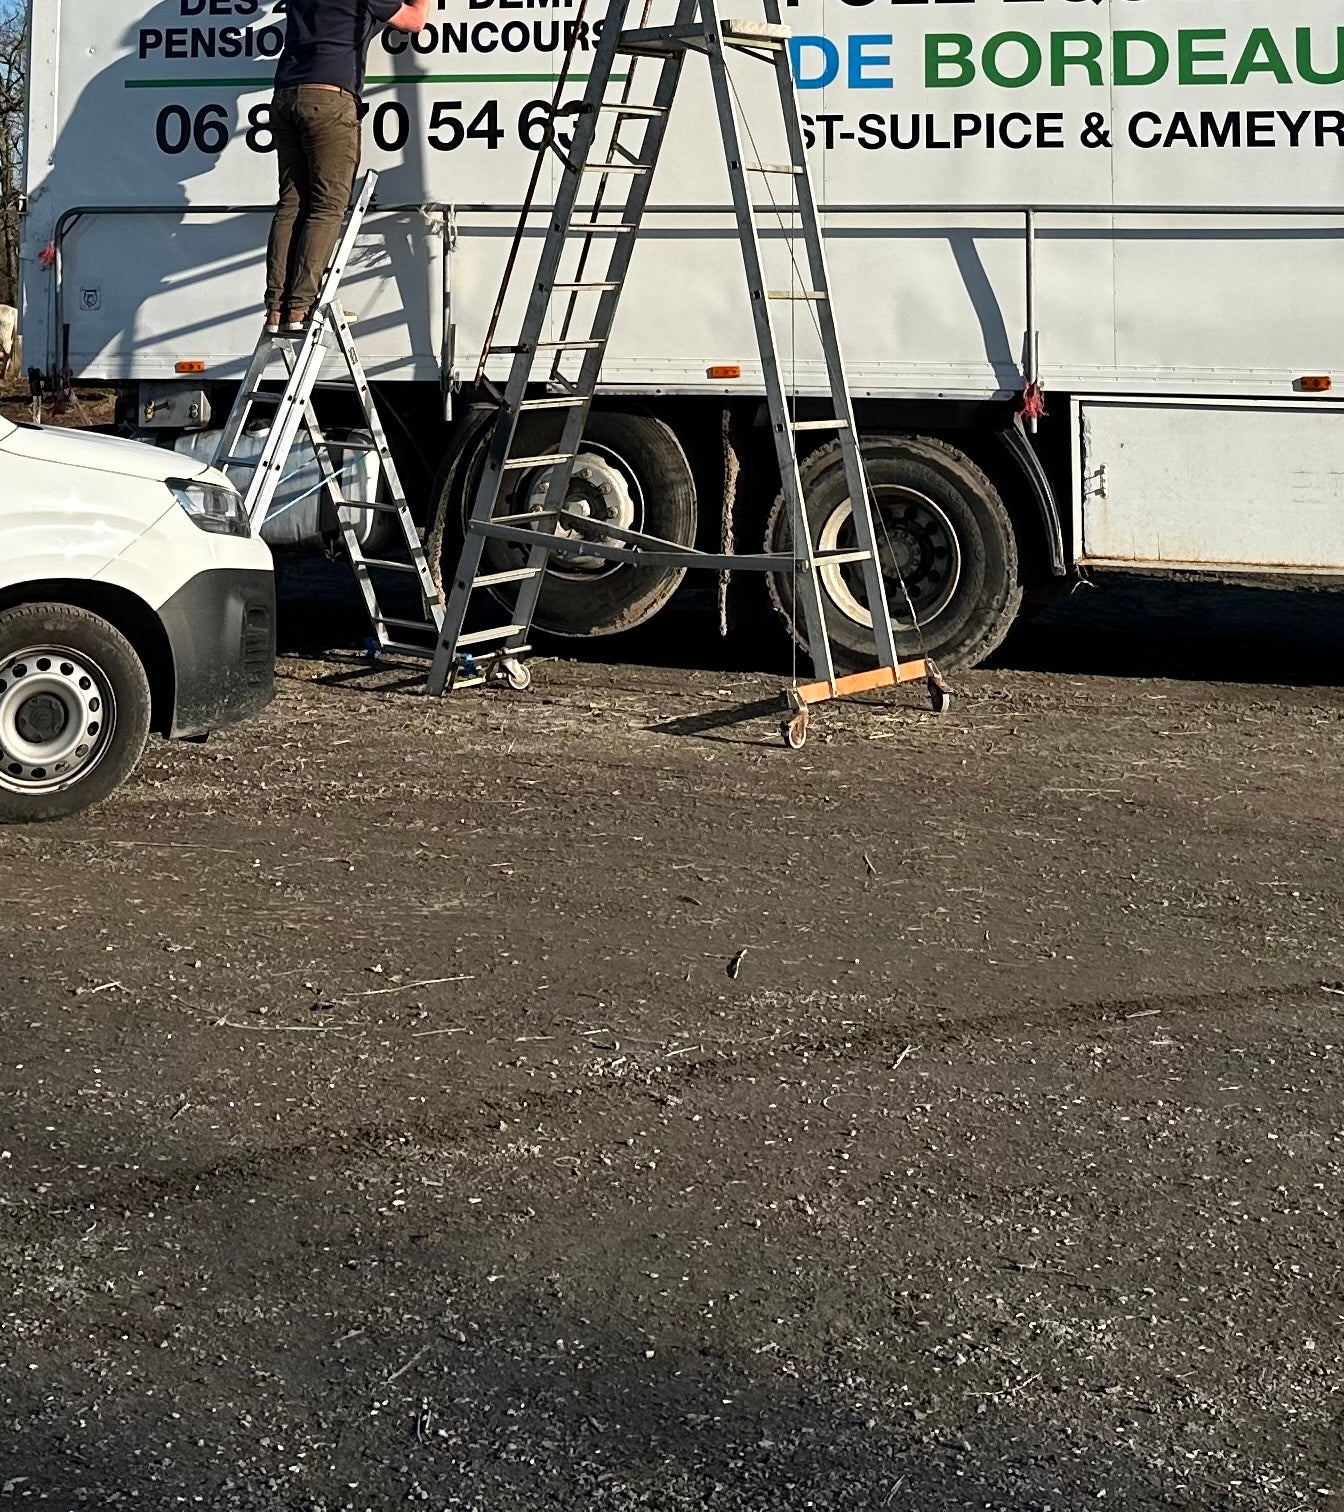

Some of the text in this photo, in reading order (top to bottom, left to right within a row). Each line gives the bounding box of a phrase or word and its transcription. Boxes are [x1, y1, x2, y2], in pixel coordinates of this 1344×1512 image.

[788, 34, 894, 89] DE
[156, 103, 229, 155] 06
[427, 100, 505, 151] 54
[800, 111, 1065, 150] ST-SULPICE
[1080, 111, 1113, 149] &
